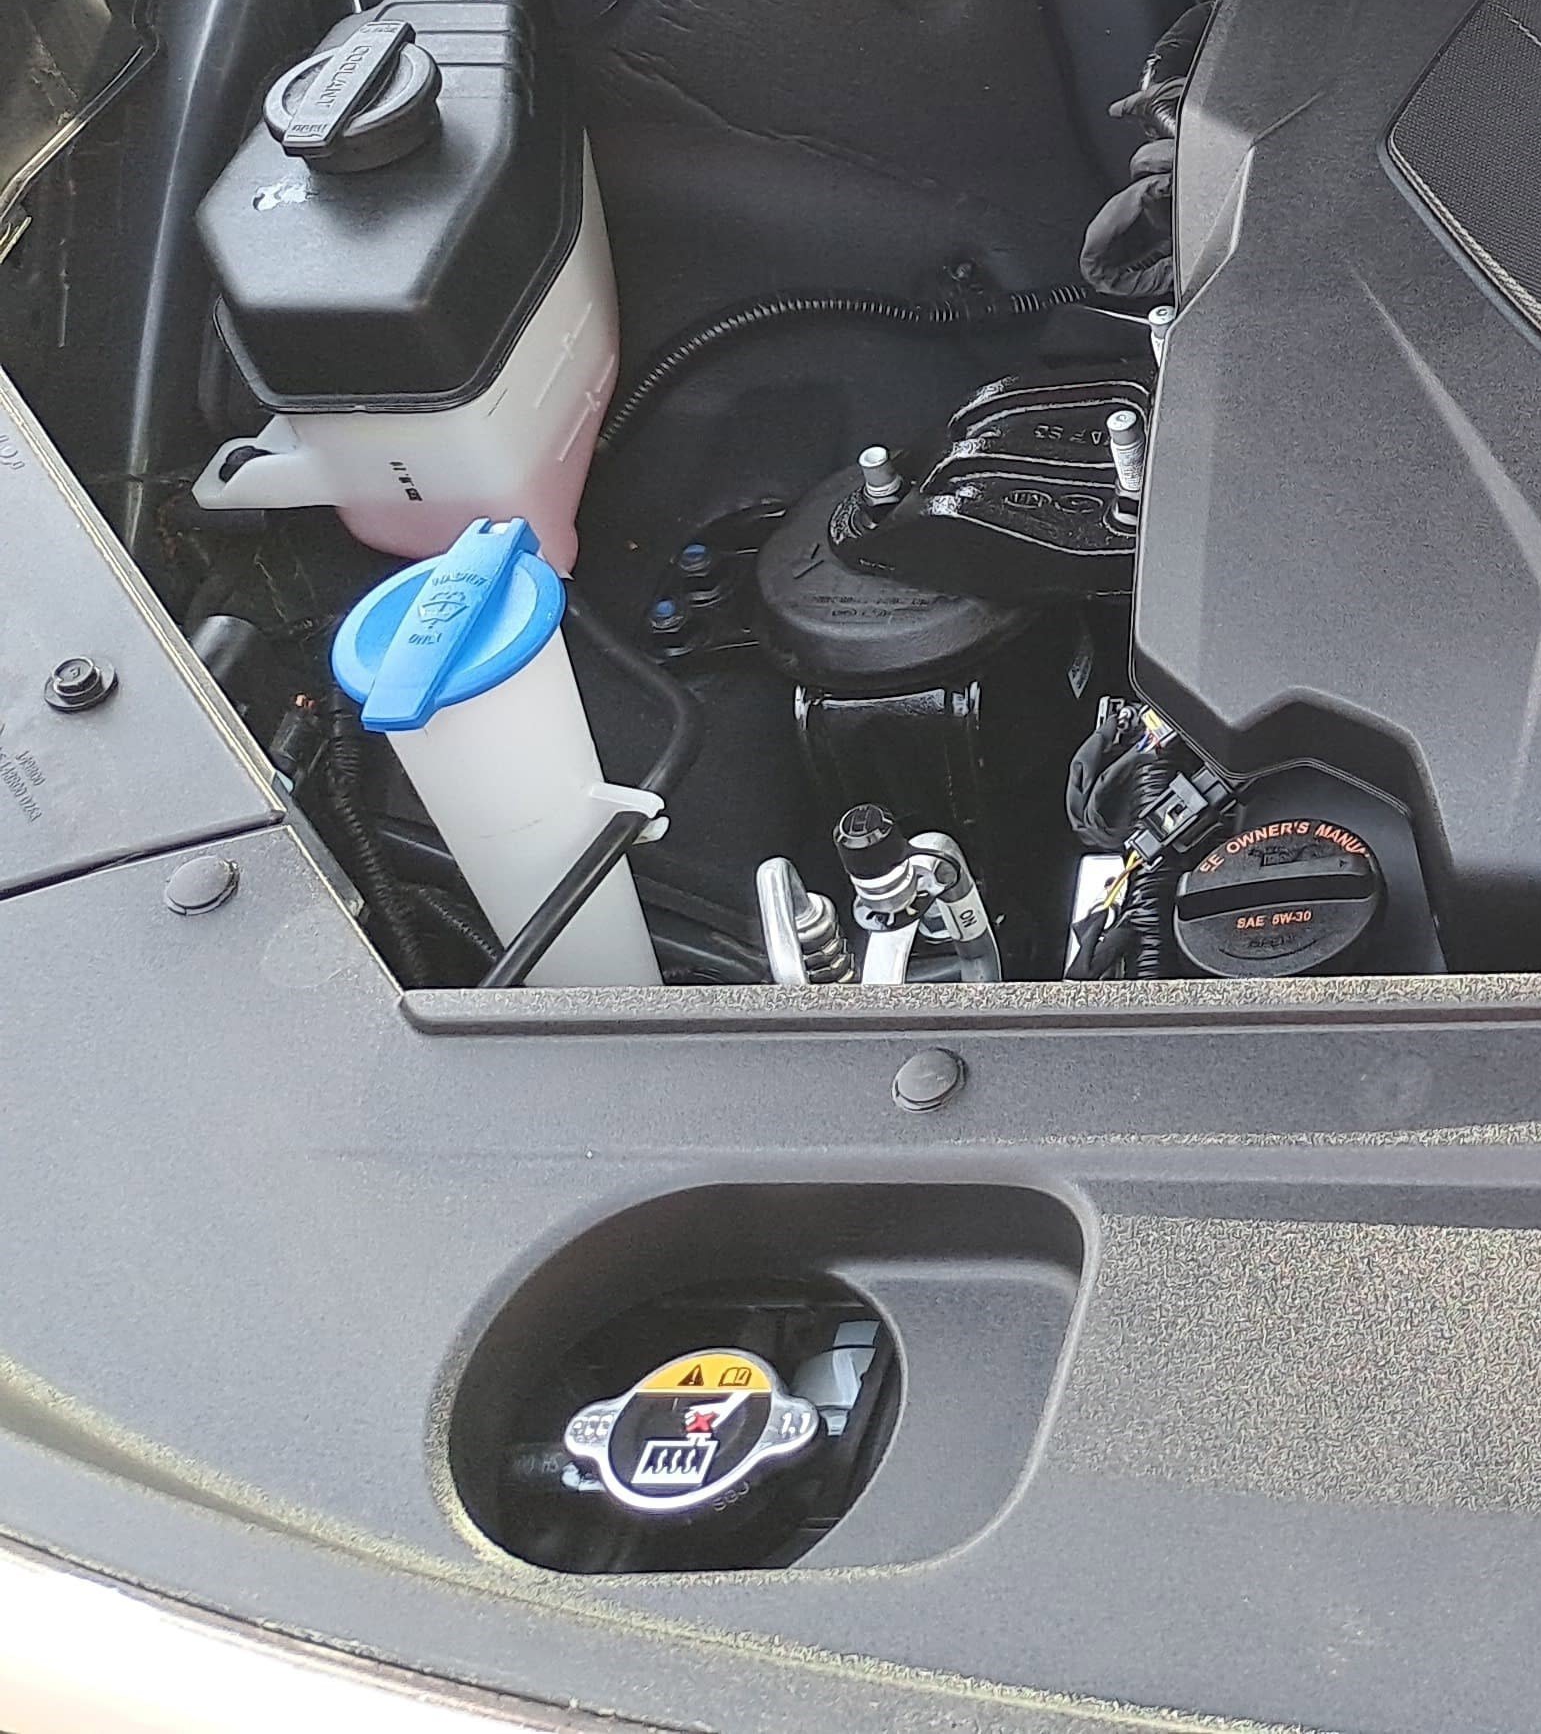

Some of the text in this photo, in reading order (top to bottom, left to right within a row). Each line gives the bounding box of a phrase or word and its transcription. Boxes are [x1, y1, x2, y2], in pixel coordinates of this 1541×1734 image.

[317, 45, 372, 108] COOLANT
[1226, 820, 1310, 854] OWNER'S
[1236, 915, 1267, 929] SAE
